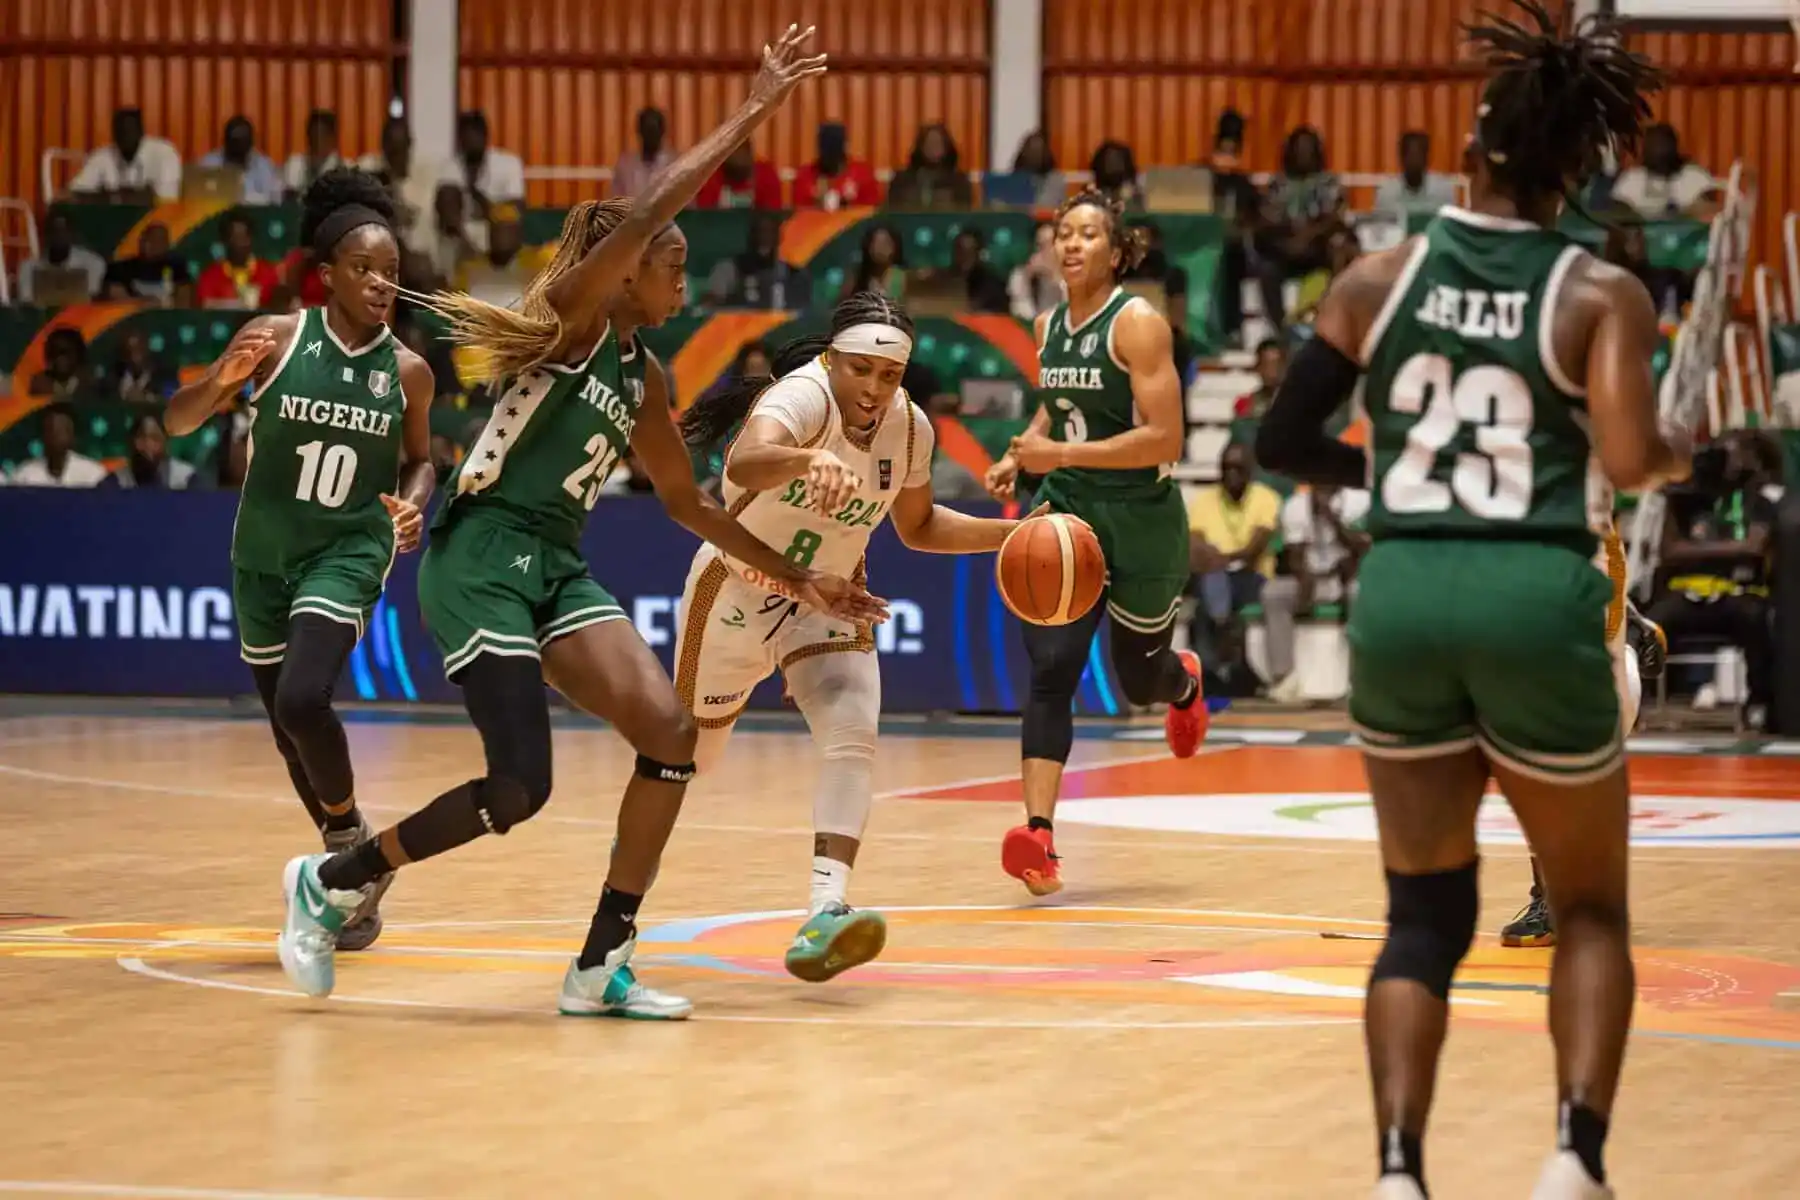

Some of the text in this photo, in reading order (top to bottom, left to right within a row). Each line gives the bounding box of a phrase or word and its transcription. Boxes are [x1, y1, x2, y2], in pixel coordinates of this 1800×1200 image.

[1039, 367, 1104, 390] IGERIA
[279, 394, 393, 437] NIGERIA
[1382, 352, 1535, 522] 23
[295, 439, 358, 508] 10
[562, 432, 618, 512] 25
[784, 528, 823, 568] 8
